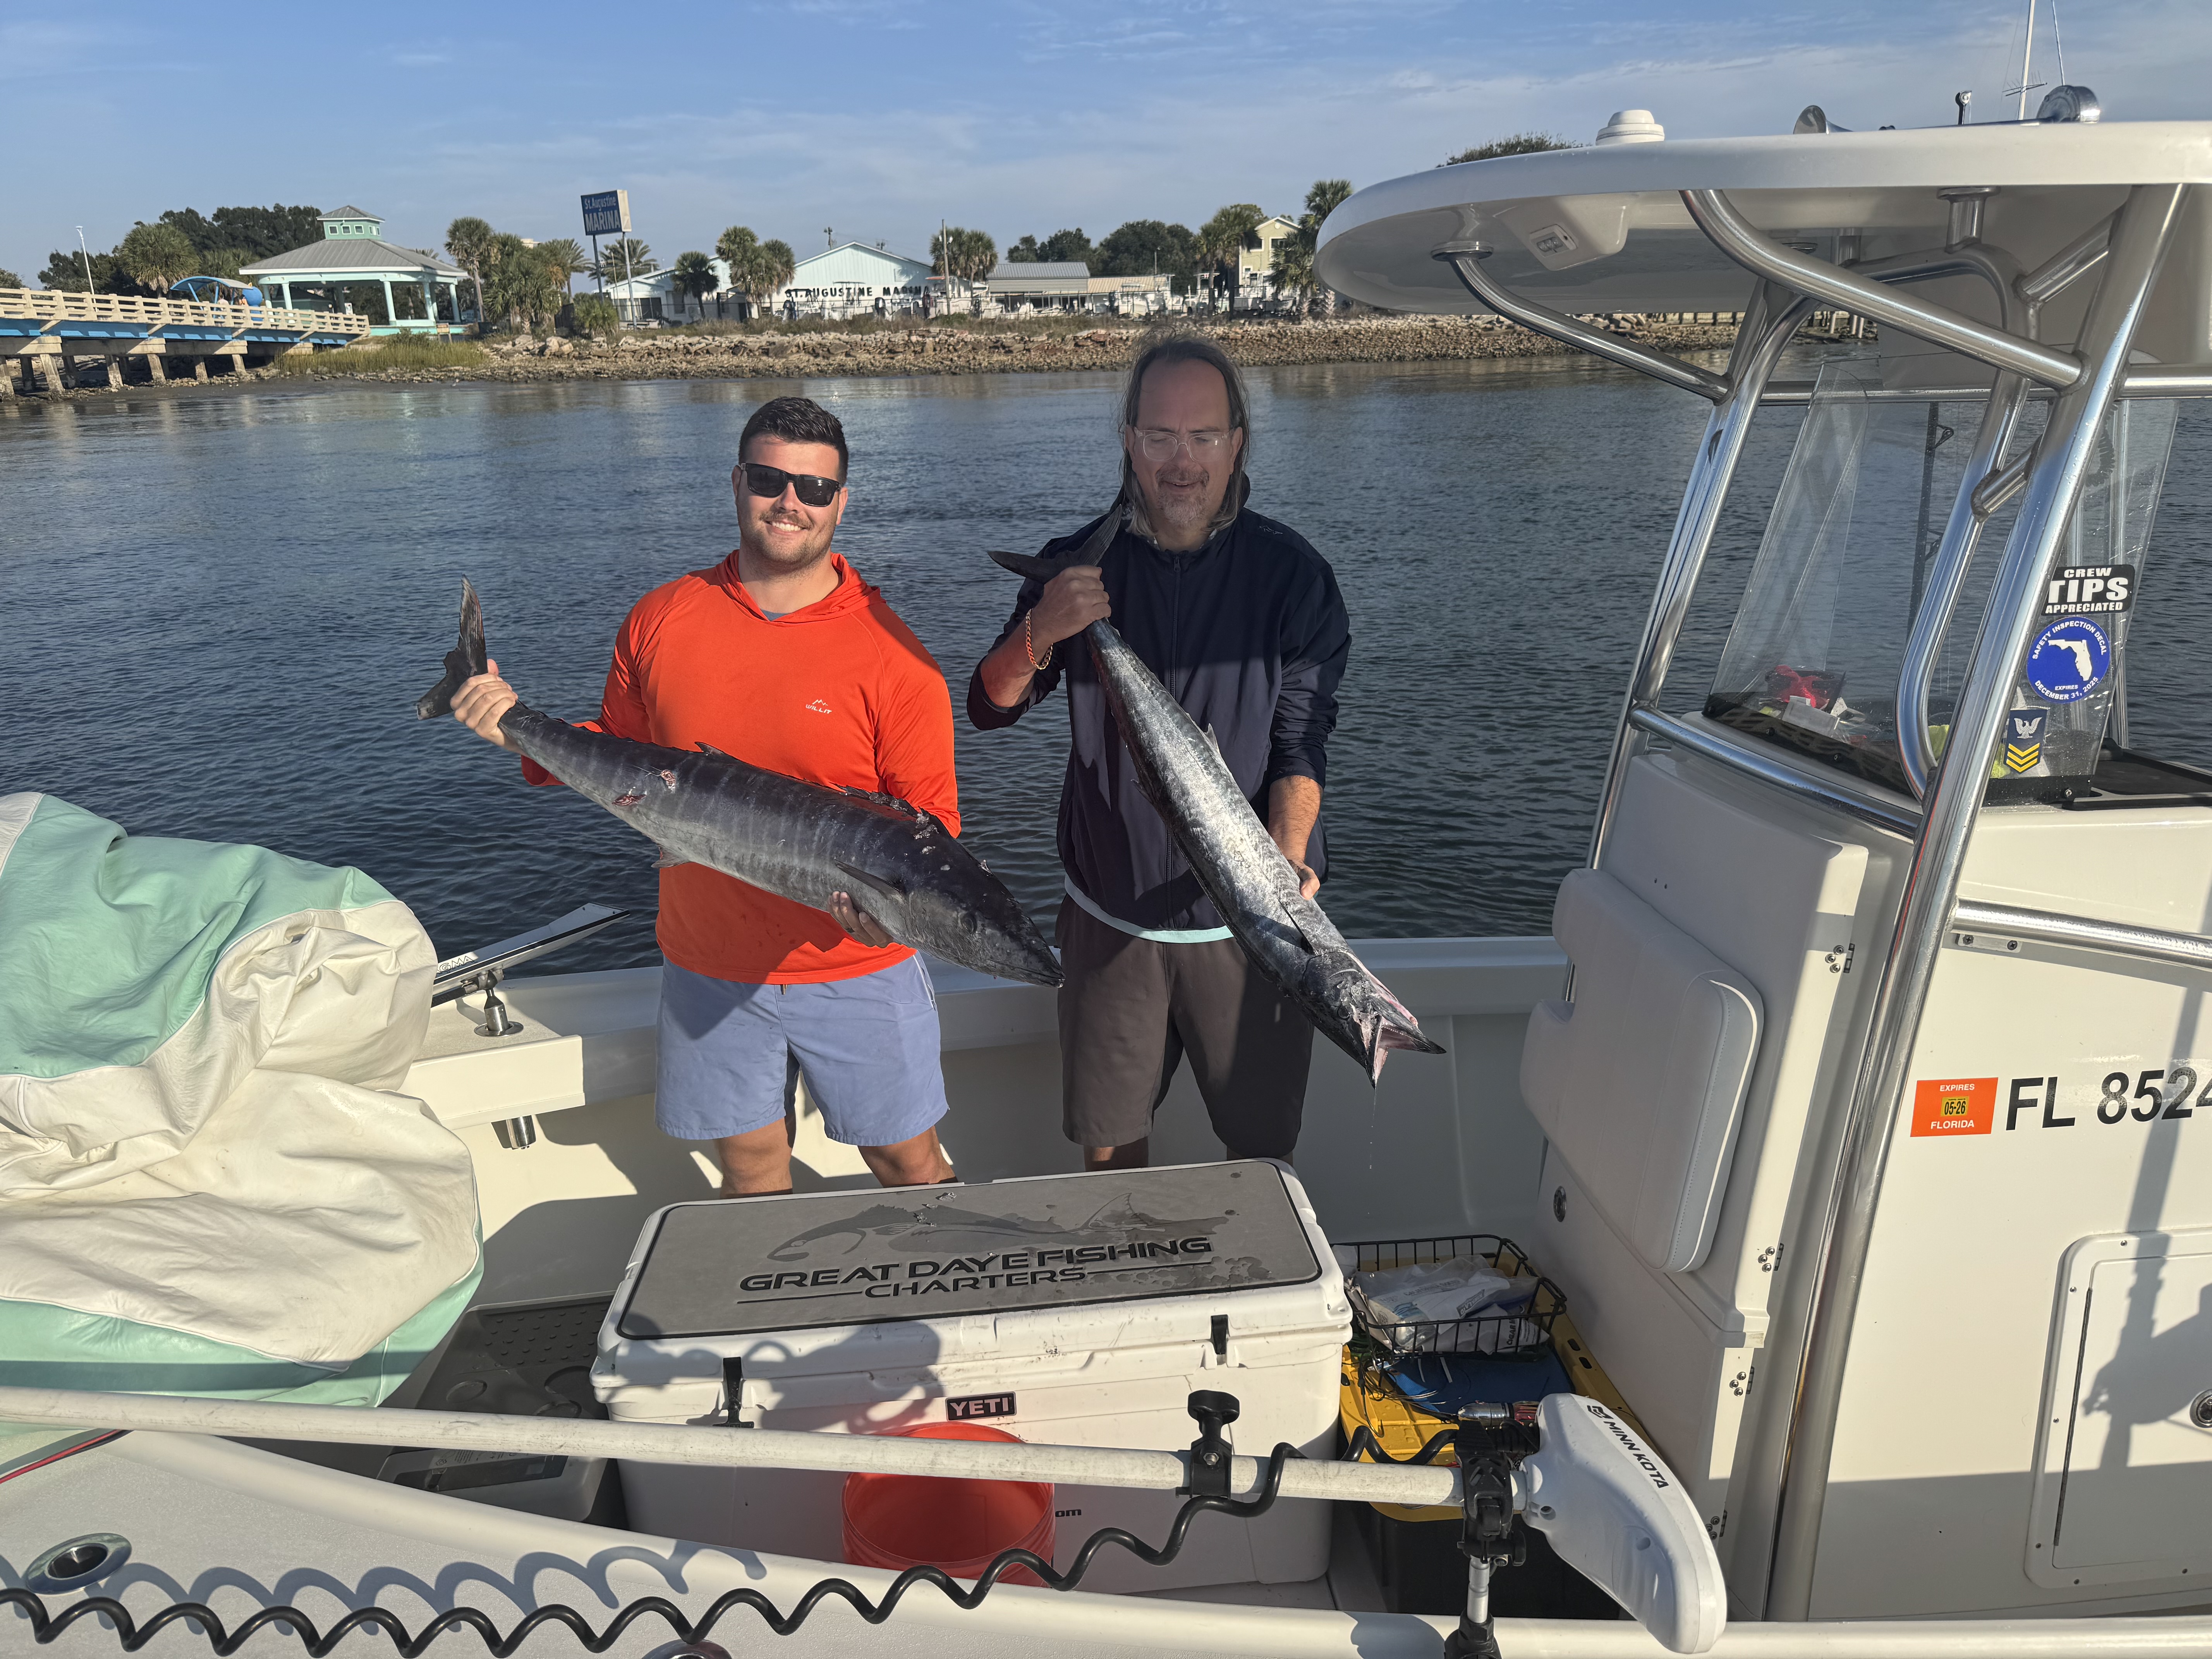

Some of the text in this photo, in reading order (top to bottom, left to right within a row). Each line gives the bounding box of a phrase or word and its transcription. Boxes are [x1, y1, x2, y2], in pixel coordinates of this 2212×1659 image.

[585, 210, 620, 232] MARINA
[2064, 567, 2112, 578] CREW
[2048, 577, 2128, 603] TIPS
[2045, 602, 2123, 614] APPRECIATED
[2032, 620, 2107, 659] SAFETY INSPECTION DECAL
[2035, 680, 2069, 700] DECEMBER
[437, 955, 474, 974] GMA
[1939, 1084, 1975, 1092] EXPIRES
[1944, 1101, 1966, 1115] 05-26
[2006, 1076, 2076, 1131] FL
[1930, 1120, 1975, 1129] FLORIDA
[740, 1237, 1212, 1291] GREAT DAYE FISHING
[865, 1267, 1085, 1298] CHARTERS
[950, 1397, 1009, 1416] YETI
[1603, 1421, 1669, 1488] MINN KOTA
